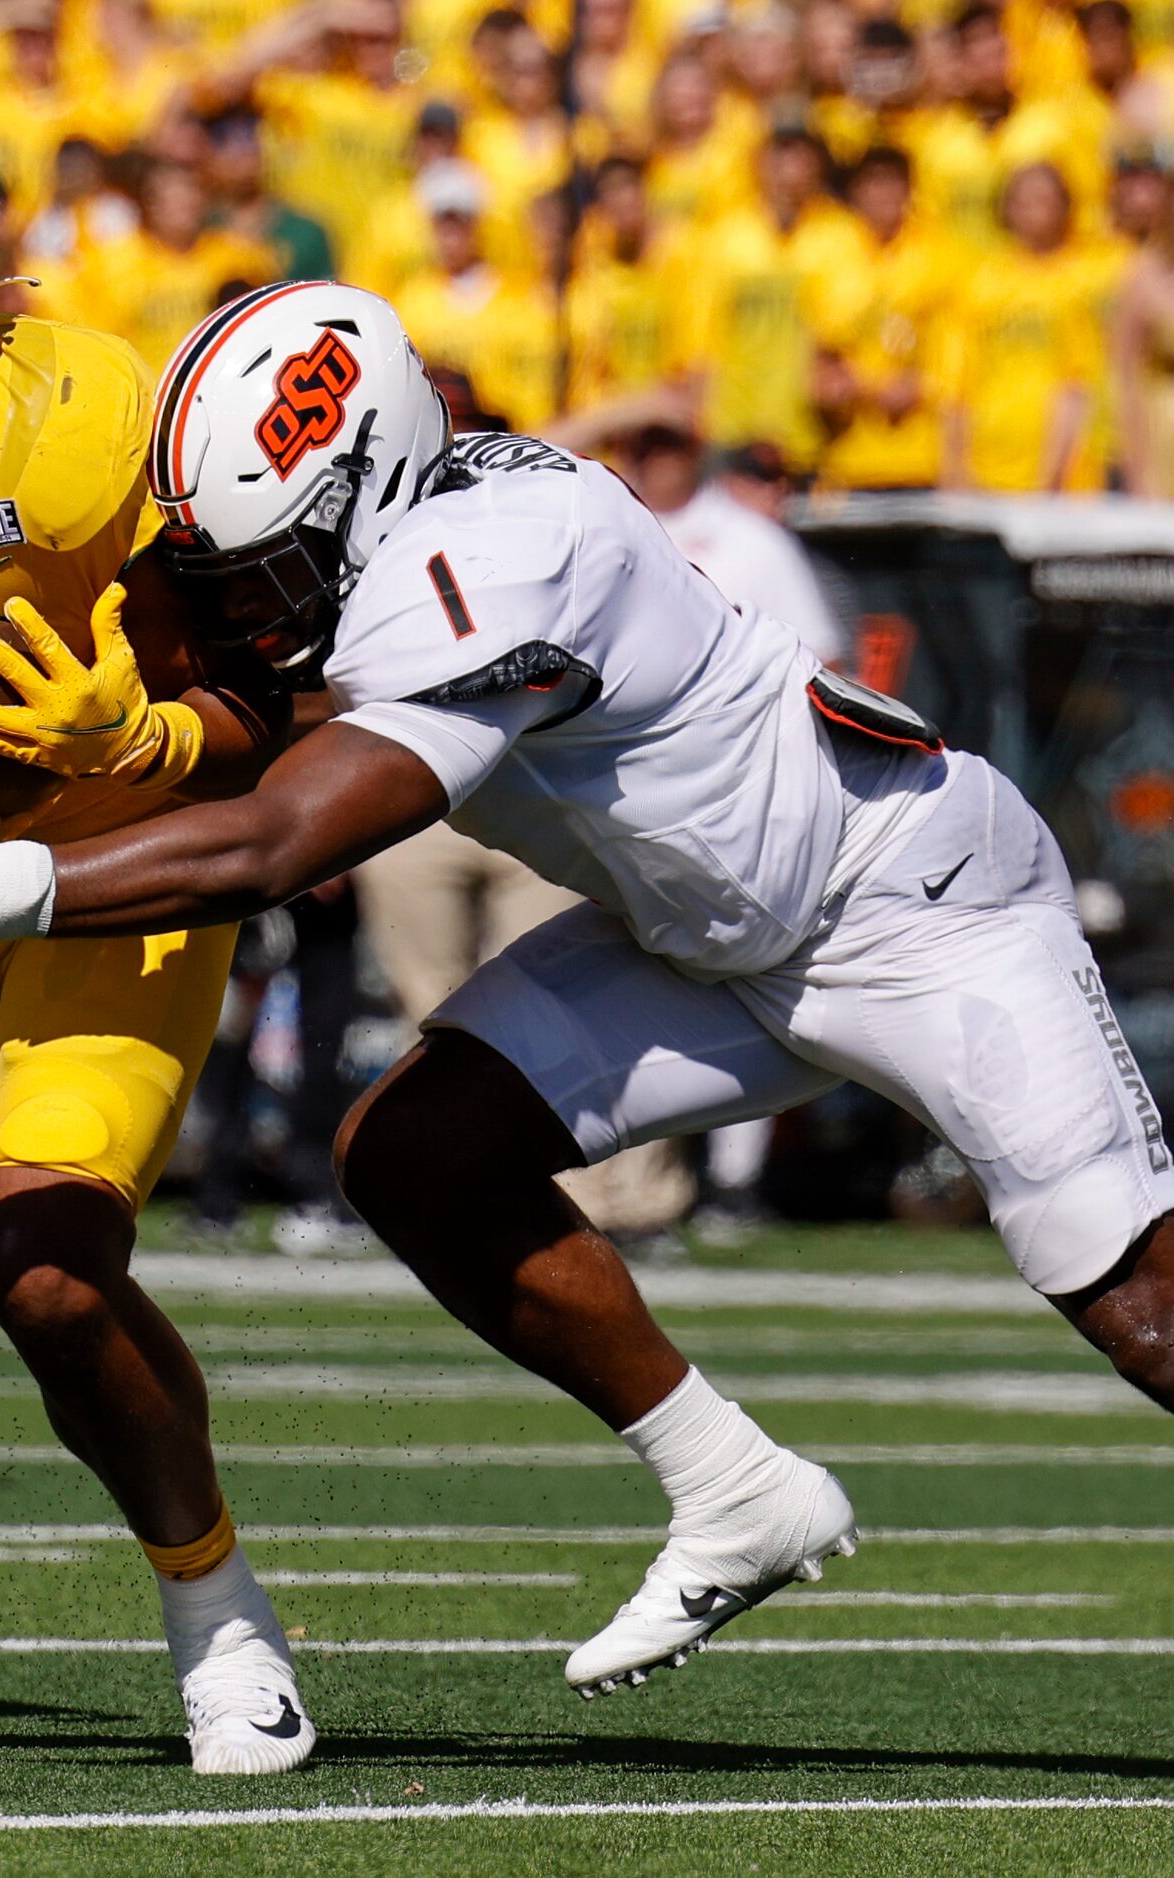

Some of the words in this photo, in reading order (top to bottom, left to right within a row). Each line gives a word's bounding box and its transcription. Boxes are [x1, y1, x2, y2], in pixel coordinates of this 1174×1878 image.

[254, 326, 362, 483] OSU
[426, 550, 477, 640] 1
[1071, 966, 1170, 1175] COWBOYS
